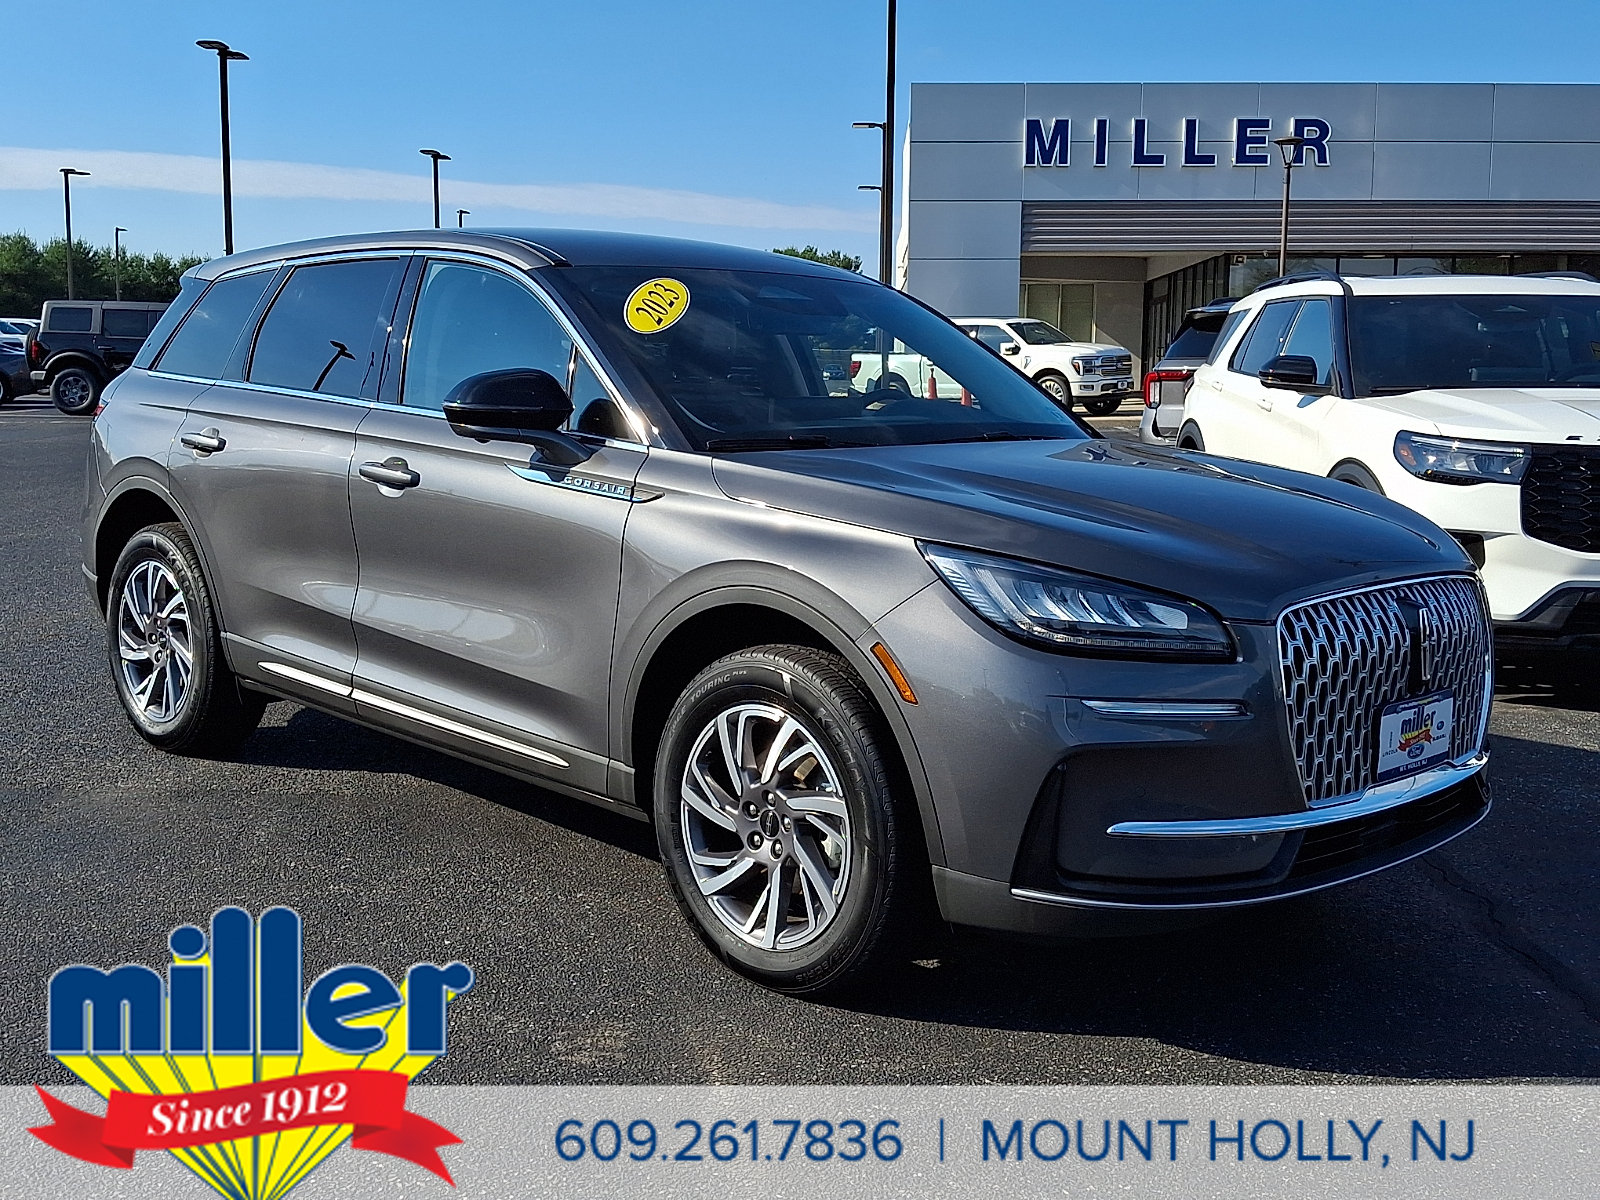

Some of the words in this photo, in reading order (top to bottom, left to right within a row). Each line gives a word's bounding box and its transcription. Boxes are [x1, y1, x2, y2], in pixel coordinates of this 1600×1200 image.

[1023, 117, 1332, 167] MILLER
[635, 283, 680, 326] 2023
[563, 475, 626, 495] CORSAIR
[690, 674, 731, 704] TOURING
[1400, 706, 1437, 735] miller
